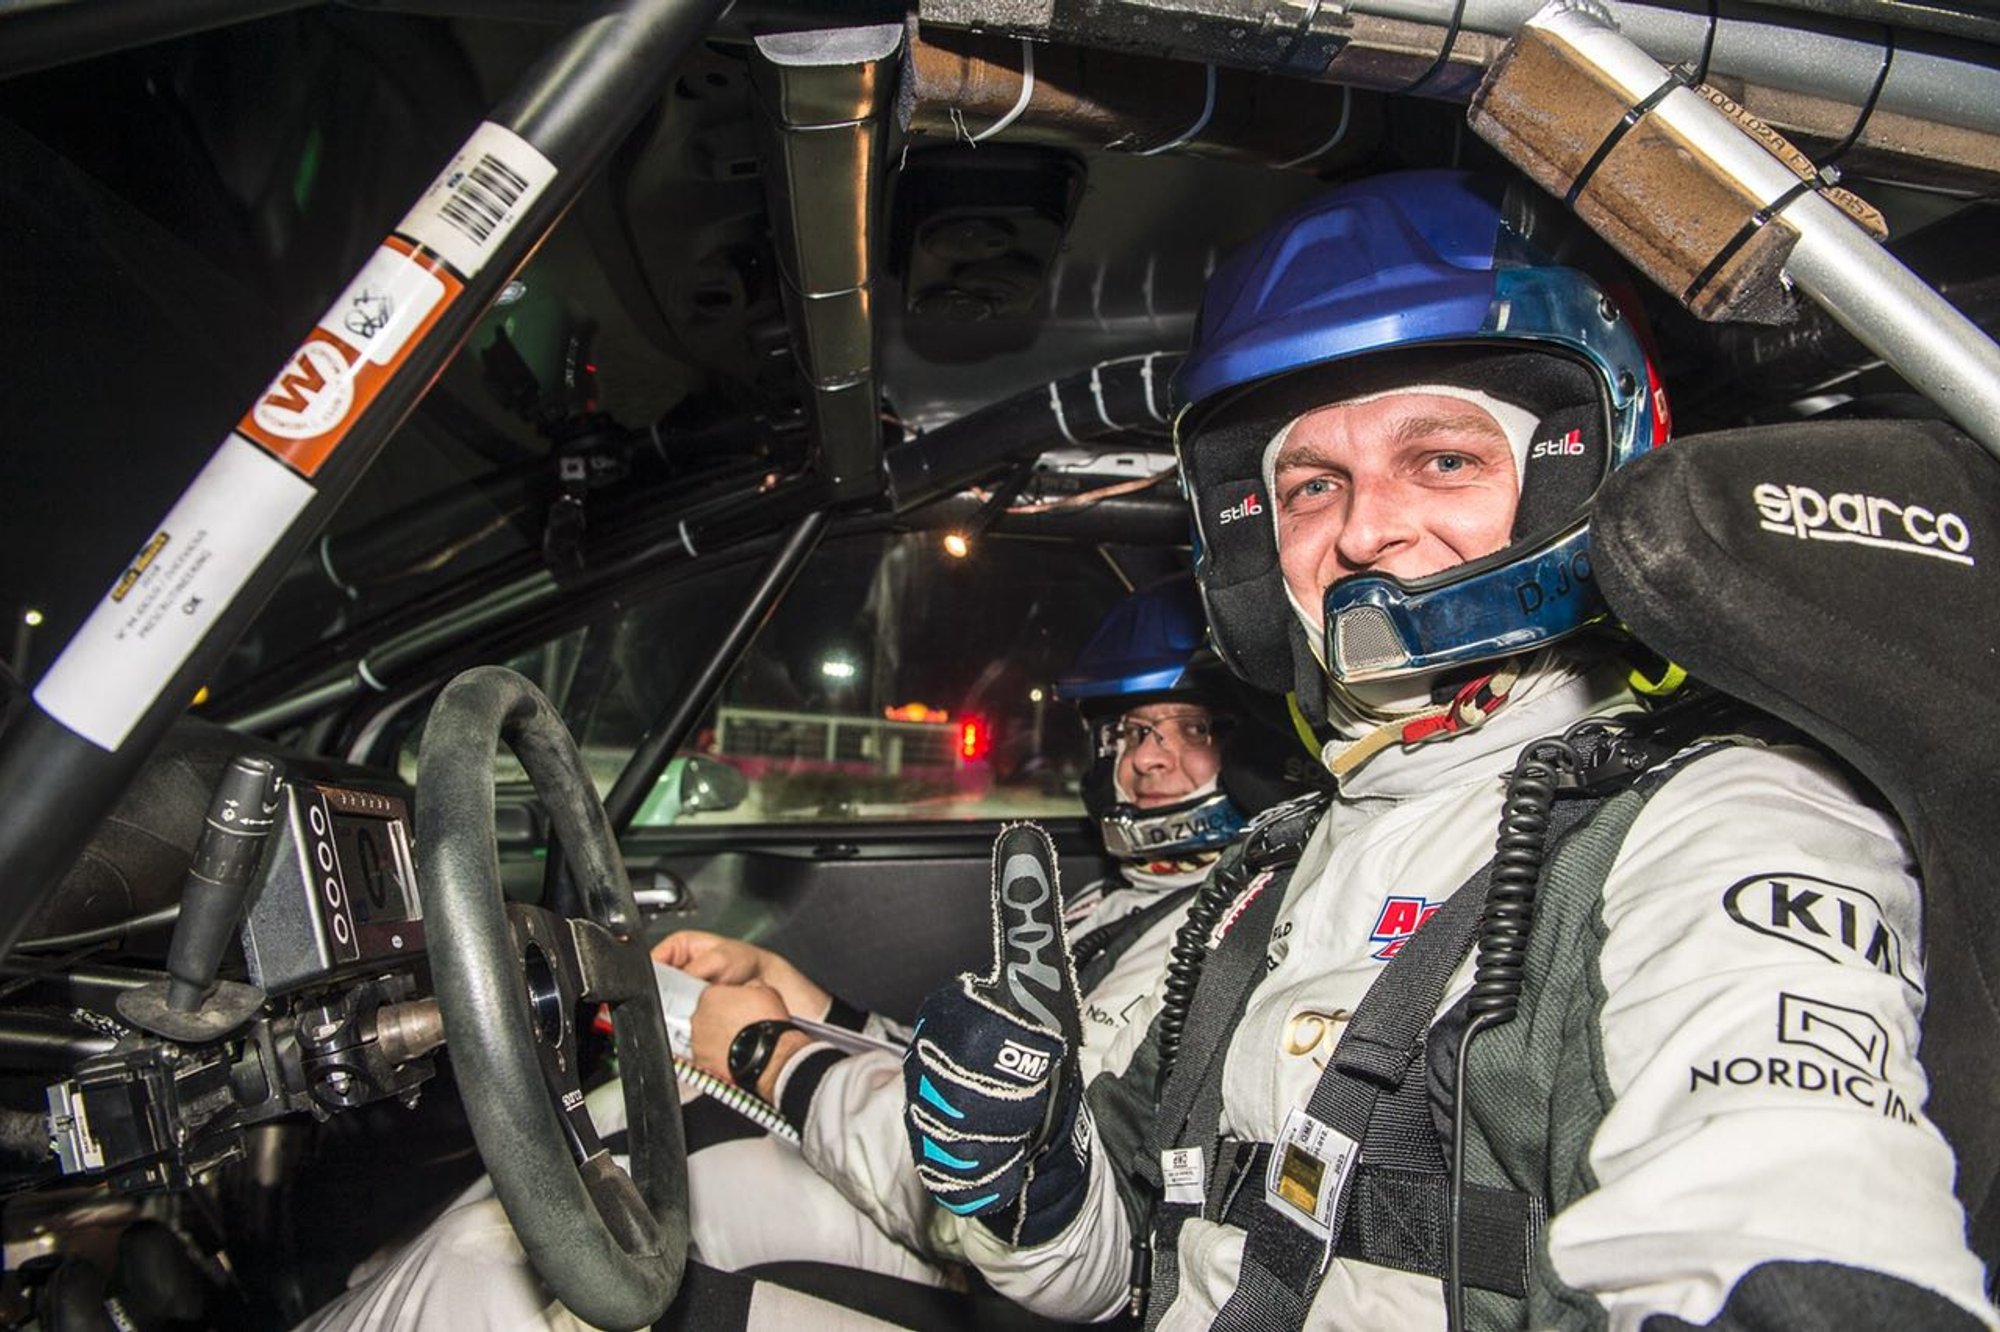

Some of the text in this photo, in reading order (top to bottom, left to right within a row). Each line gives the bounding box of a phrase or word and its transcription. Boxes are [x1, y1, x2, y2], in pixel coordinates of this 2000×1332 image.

[264, 352, 327, 414] W
[1531, 432, 1585, 459] stilo
[1220, 496, 1263, 525] stilo
[1753, 483, 1971, 556] sparco
[997, 1044, 1050, 1079] OMP
[1690, 1057, 1874, 1107] NORDIC
